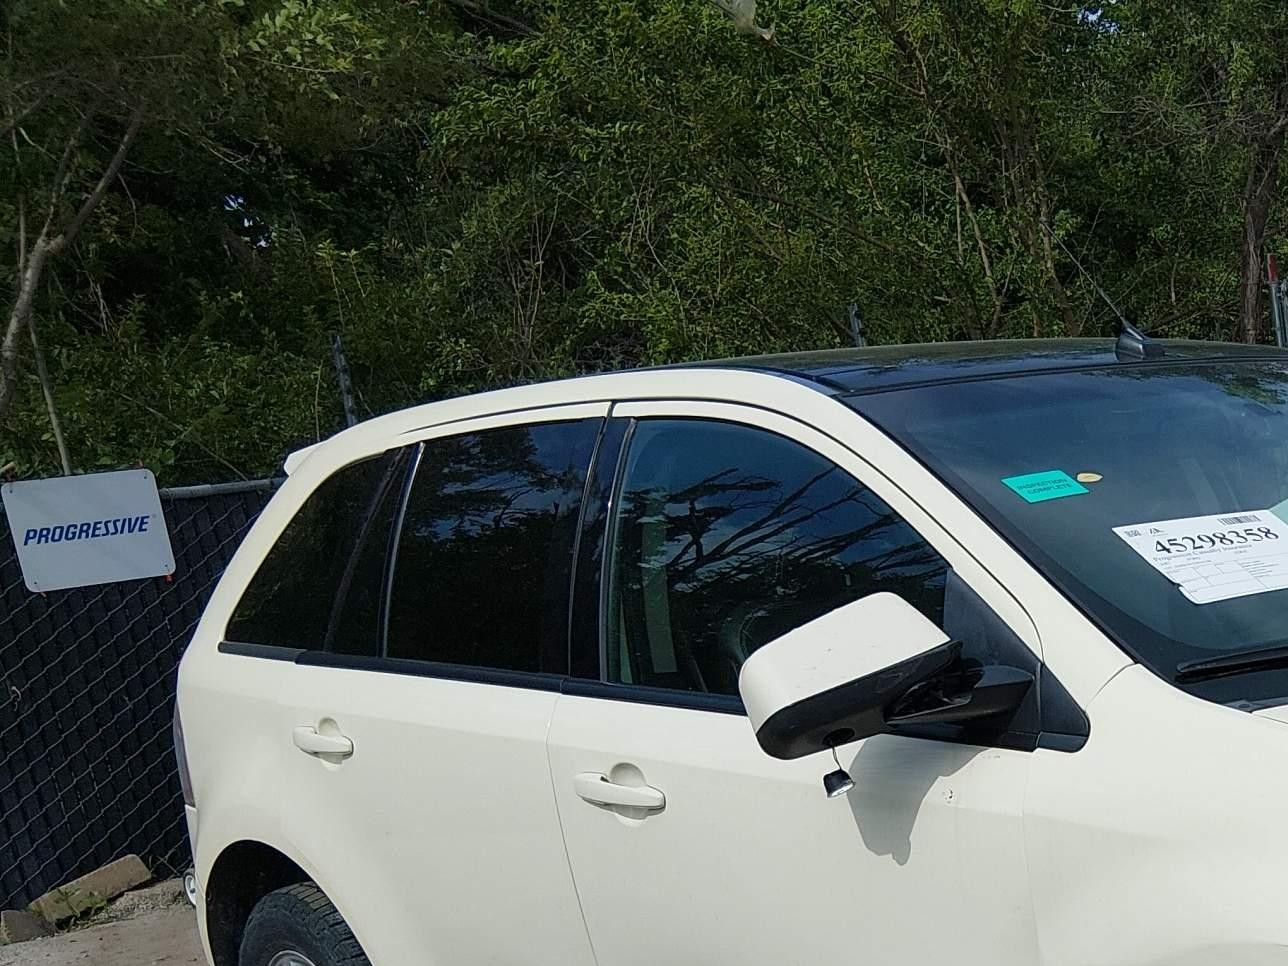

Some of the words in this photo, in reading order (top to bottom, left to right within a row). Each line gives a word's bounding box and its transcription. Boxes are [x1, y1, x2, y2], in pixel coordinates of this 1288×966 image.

[1026, 483, 1073, 495] COMPLETE
[23, 515, 150, 546] PROGRESSIVE
[1154, 526, 1279, 555] 45298358
